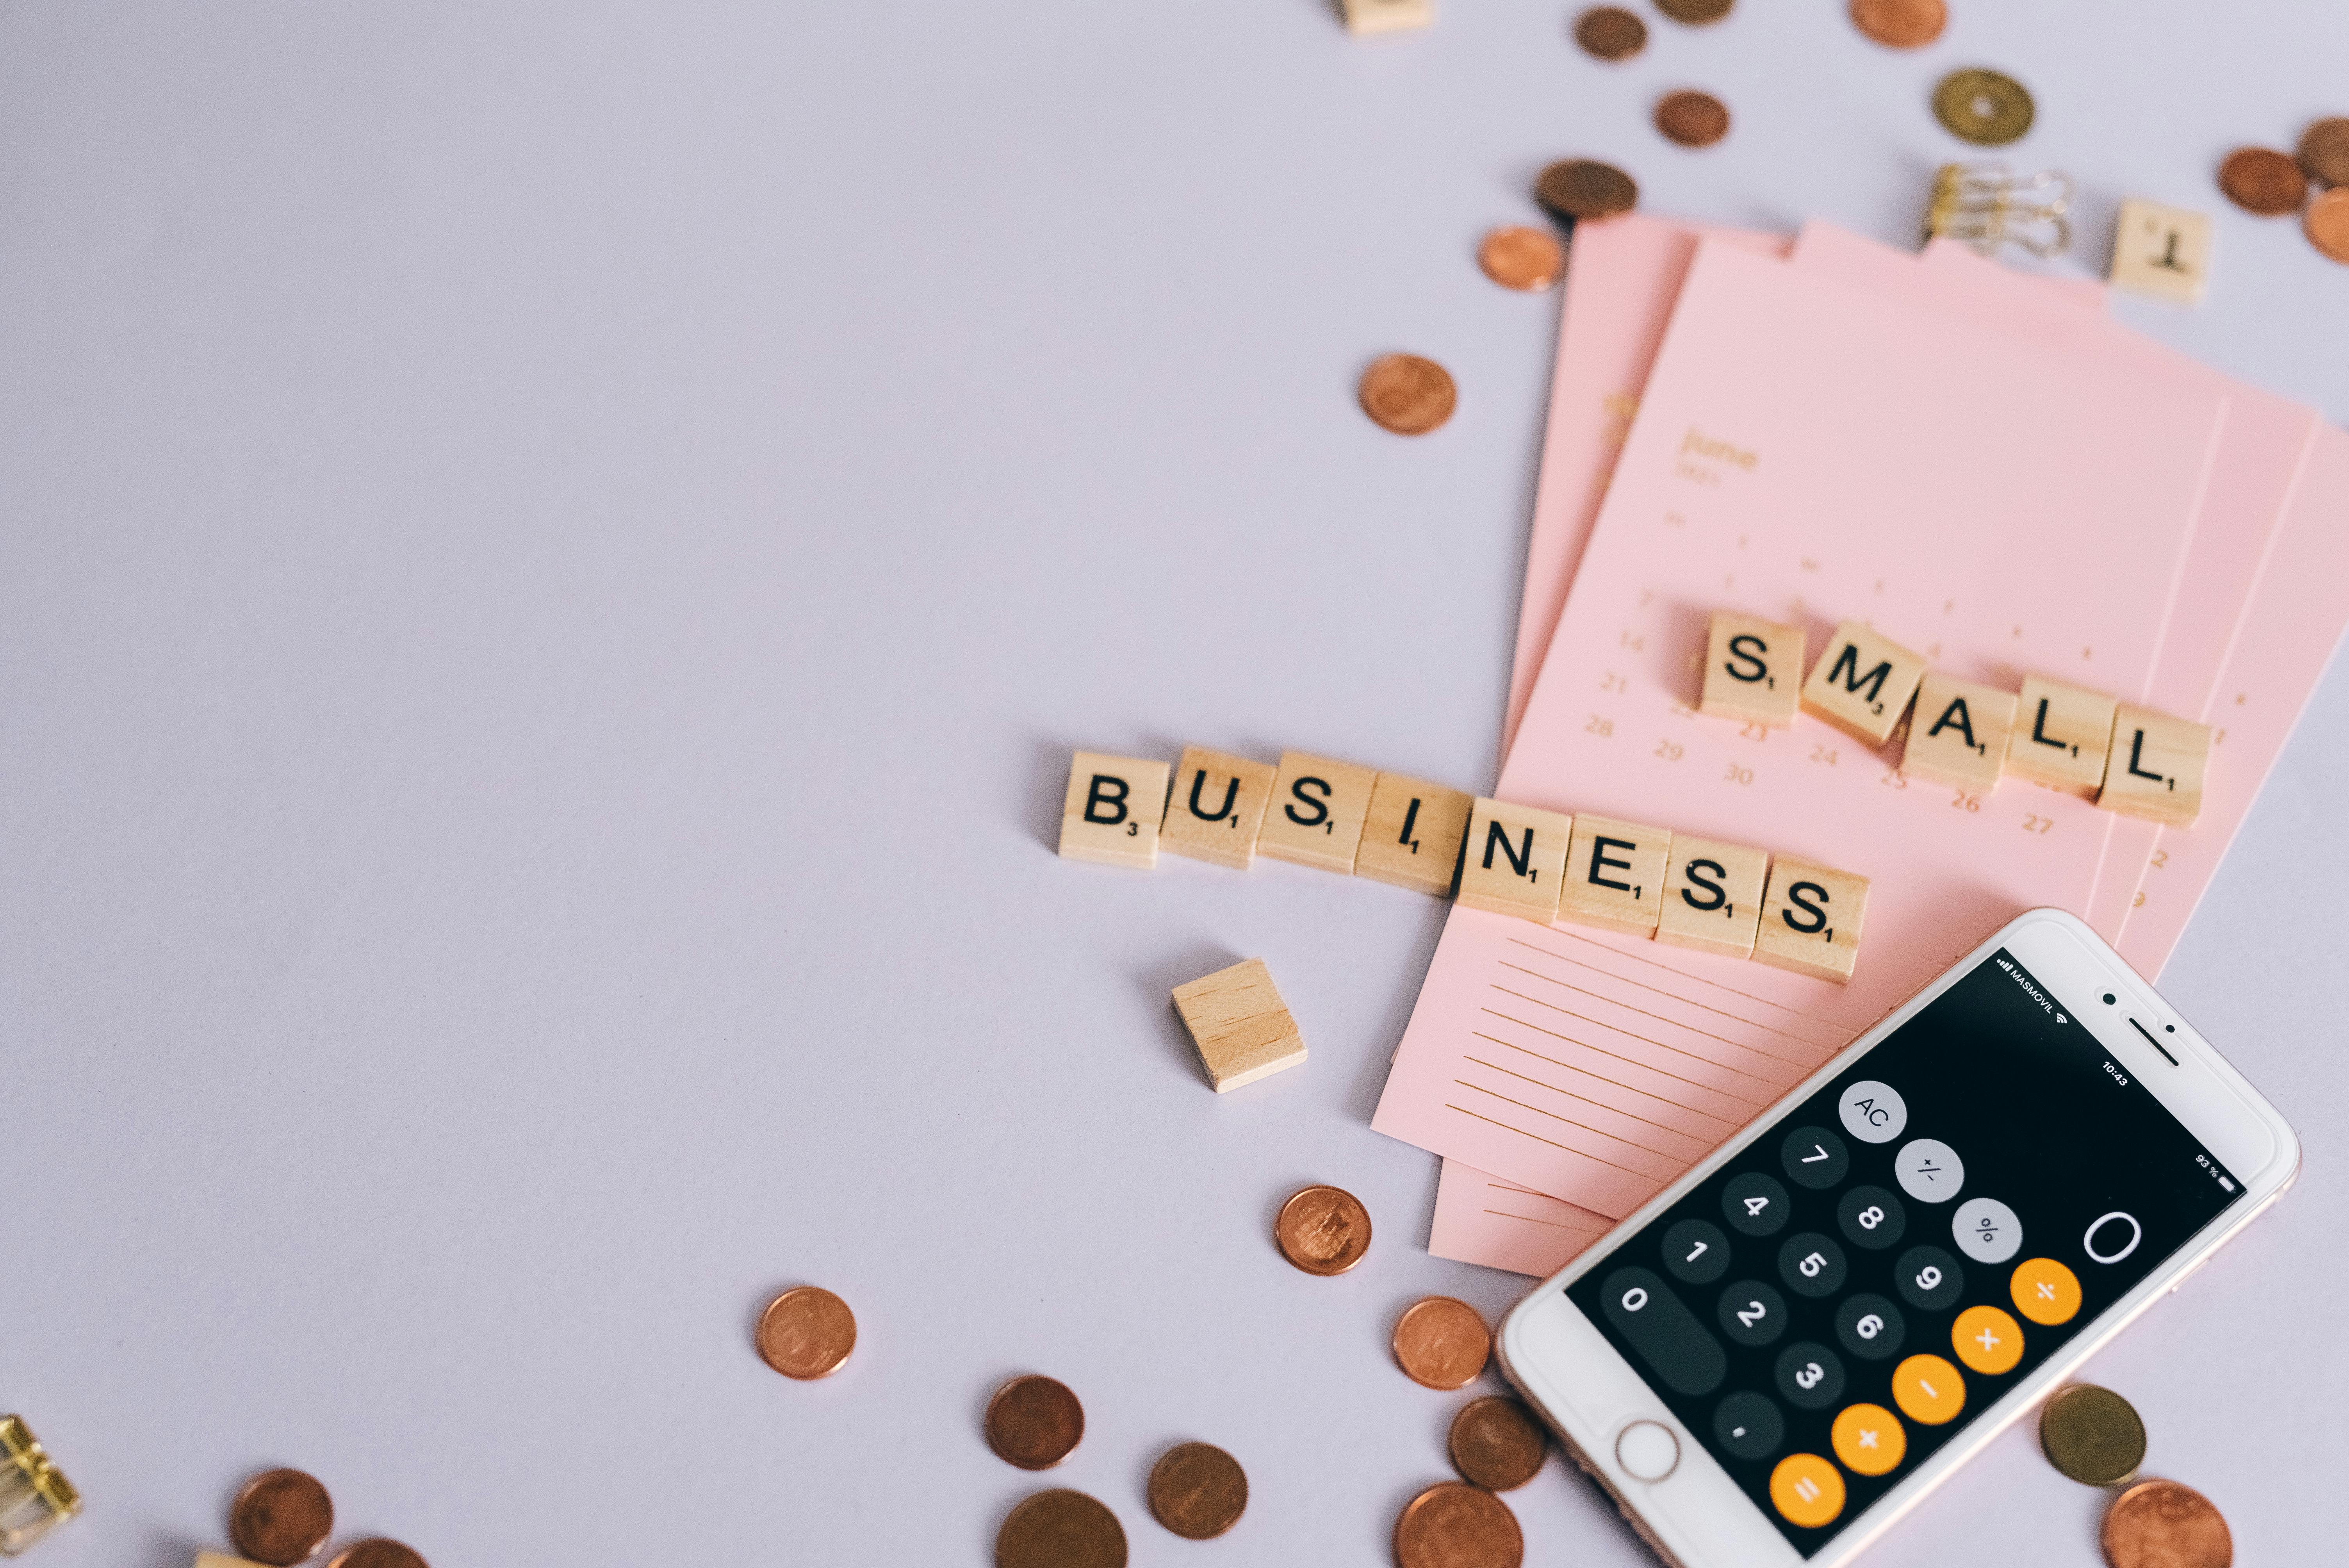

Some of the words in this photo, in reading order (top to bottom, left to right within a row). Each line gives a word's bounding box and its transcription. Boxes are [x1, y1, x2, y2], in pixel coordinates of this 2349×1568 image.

[2147, 226, 2192, 274] T
[1679, 426, 1759, 473] june
[1724, 634, 2164, 782] SMALL
[1585, 715, 1615, 738] 28
[1654, 739, 1684, 762] 29
[1724, 763, 1754, 786] 30
[1601, 672, 1627, 694] 21
[1809, 746, 1838, 768] 24
[1952, 792, 1980, 814] 26
[2022, 813, 2053, 834] 27
[1083, 768, 1830, 934] BUSINESS
[2010, 969, 2053, 1014] MASMOVIL
[2103, 1061, 2128, 1086] 10:43
[1854, 1098, 1889, 1127] AC
[1801, 1144, 1829, 1164] 7
[2196, 1154, 2210, 1168] 93
[1743, 1196, 1769, 1216] 4
[1858, 1206, 1885, 1230] 8
[1975, 1217, 1999, 1242] %
[2083, 1212, 2141, 1264] 0
[1686, 1241, 1708, 1262] 1
[1799, 1252, 1827, 1277] 5
[1915, 1265, 1943, 1290] 9
[1621, 1287, 1648, 1312] 0
[1737, 1301, 1766, 1328] 2
[1856, 1314, 1884, 1340] 6
[1795, 1362, 1824, 1389] 3
